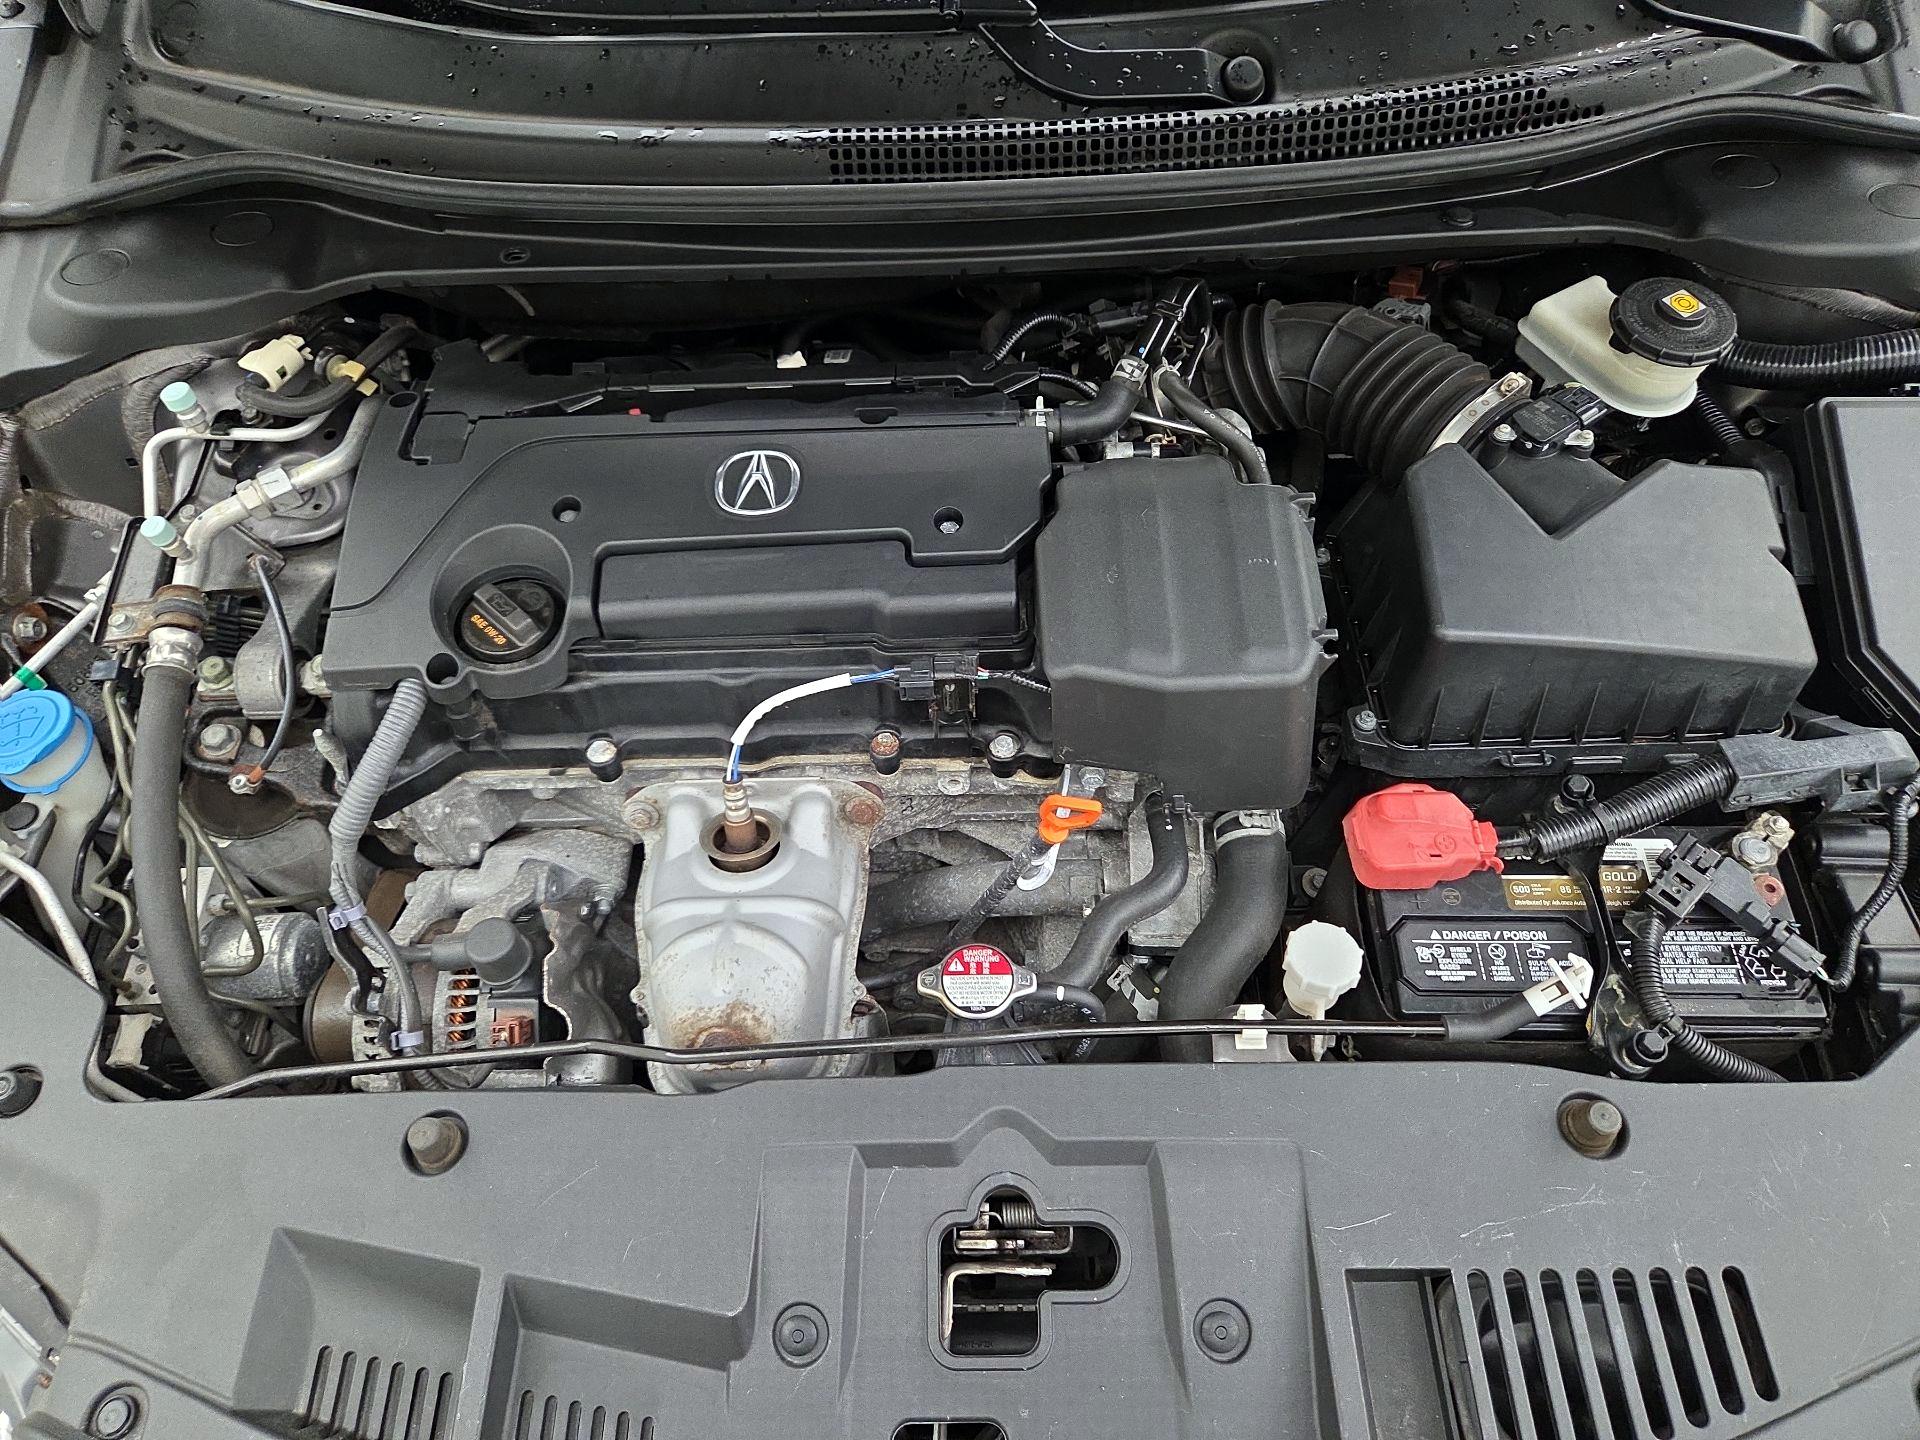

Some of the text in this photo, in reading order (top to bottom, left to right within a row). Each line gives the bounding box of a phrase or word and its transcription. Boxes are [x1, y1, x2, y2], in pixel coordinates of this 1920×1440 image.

[471, 614, 507, 645] SAE 0W-20
[1602, 871, 1637, 882] GOLD
[1512, 885, 1531, 894] 500
[1602, 885, 1622, 894] 1R-2
[1441, 930, 1492, 941] DANGER
[1502, 930, 1548, 941] POISON
[1664, 944, 1681, 952] EYES
[1681, 944, 1722, 952] IMMEDIATELY
[962, 949, 994, 957] DANGER
[963, 955, 1000, 963] WARNUNG
[1674, 957, 1692, 965] HELP
[1692, 957, 1710, 965] FAST
